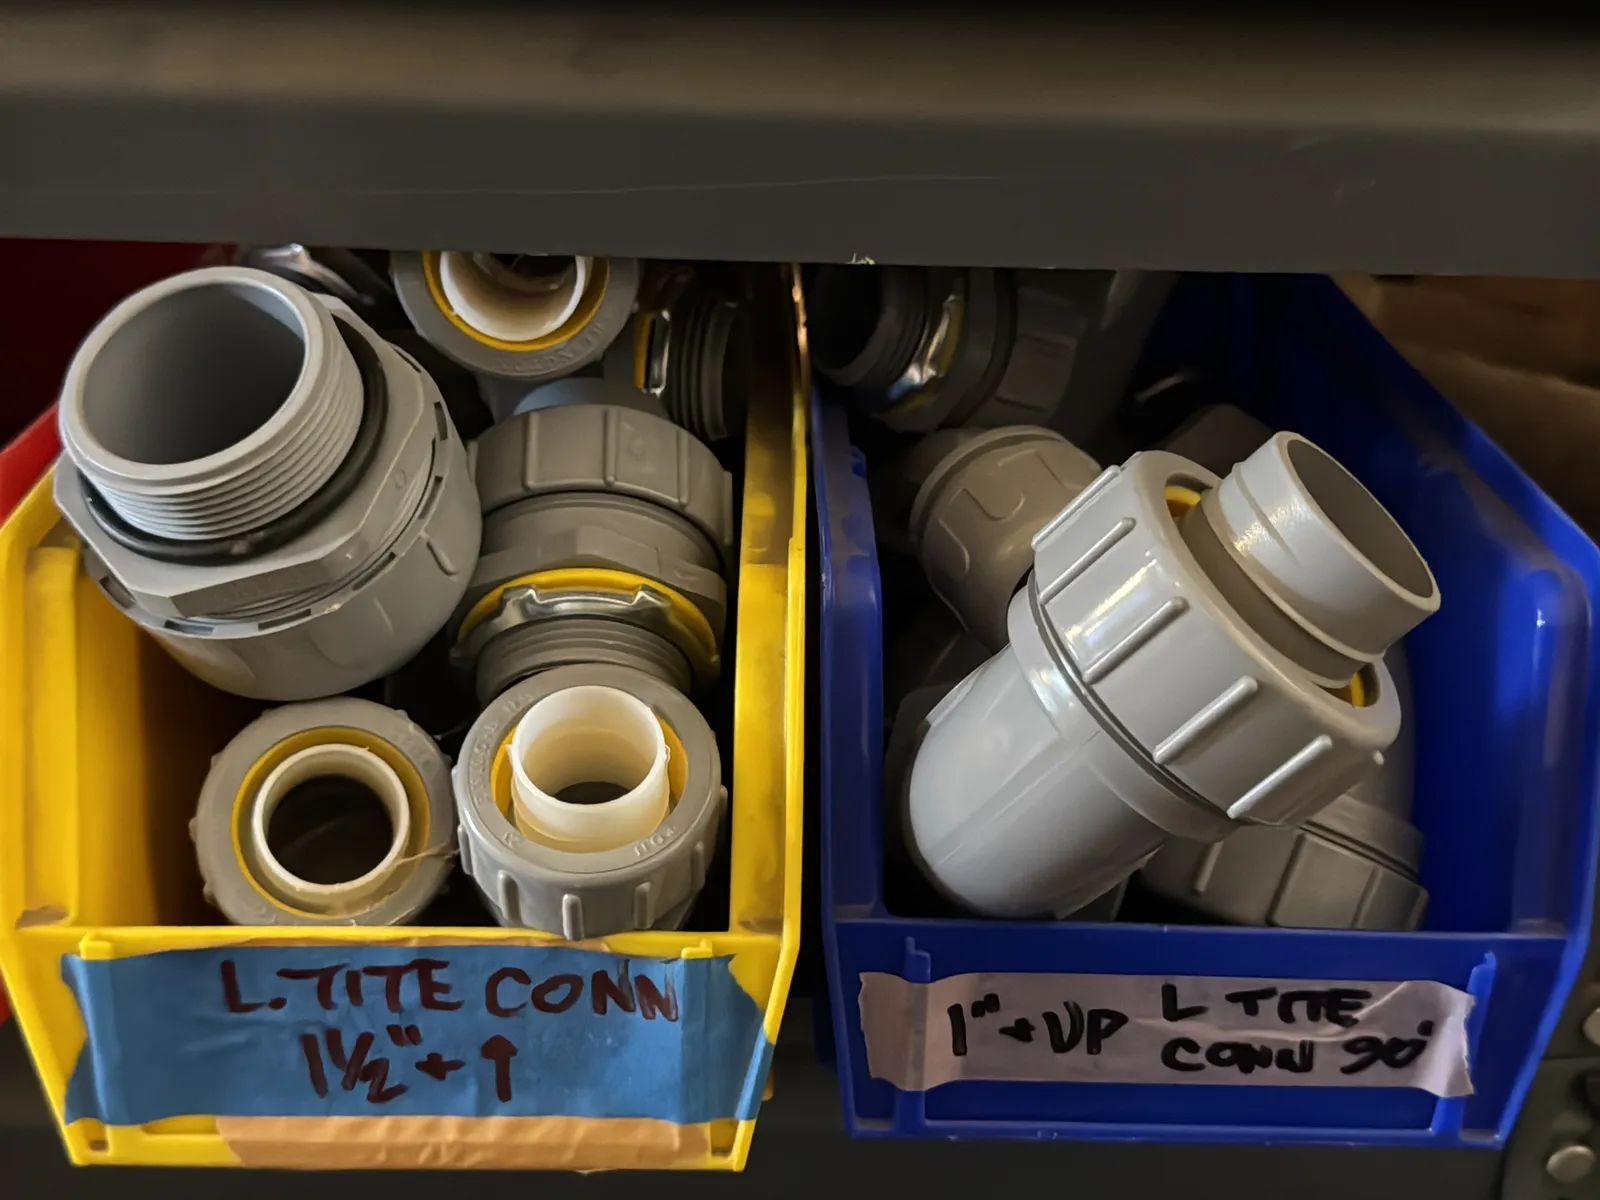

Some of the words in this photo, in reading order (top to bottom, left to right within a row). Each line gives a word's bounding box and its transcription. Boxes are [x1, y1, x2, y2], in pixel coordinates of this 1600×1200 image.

[485, 959, 679, 1023] CONN
[1161, 982, 1209, 1022] L
[1225, 987, 1372, 1028] TITE
[1042, 1001, 1128, 1055] UP
[1160, 1037, 1314, 1074] CONN
